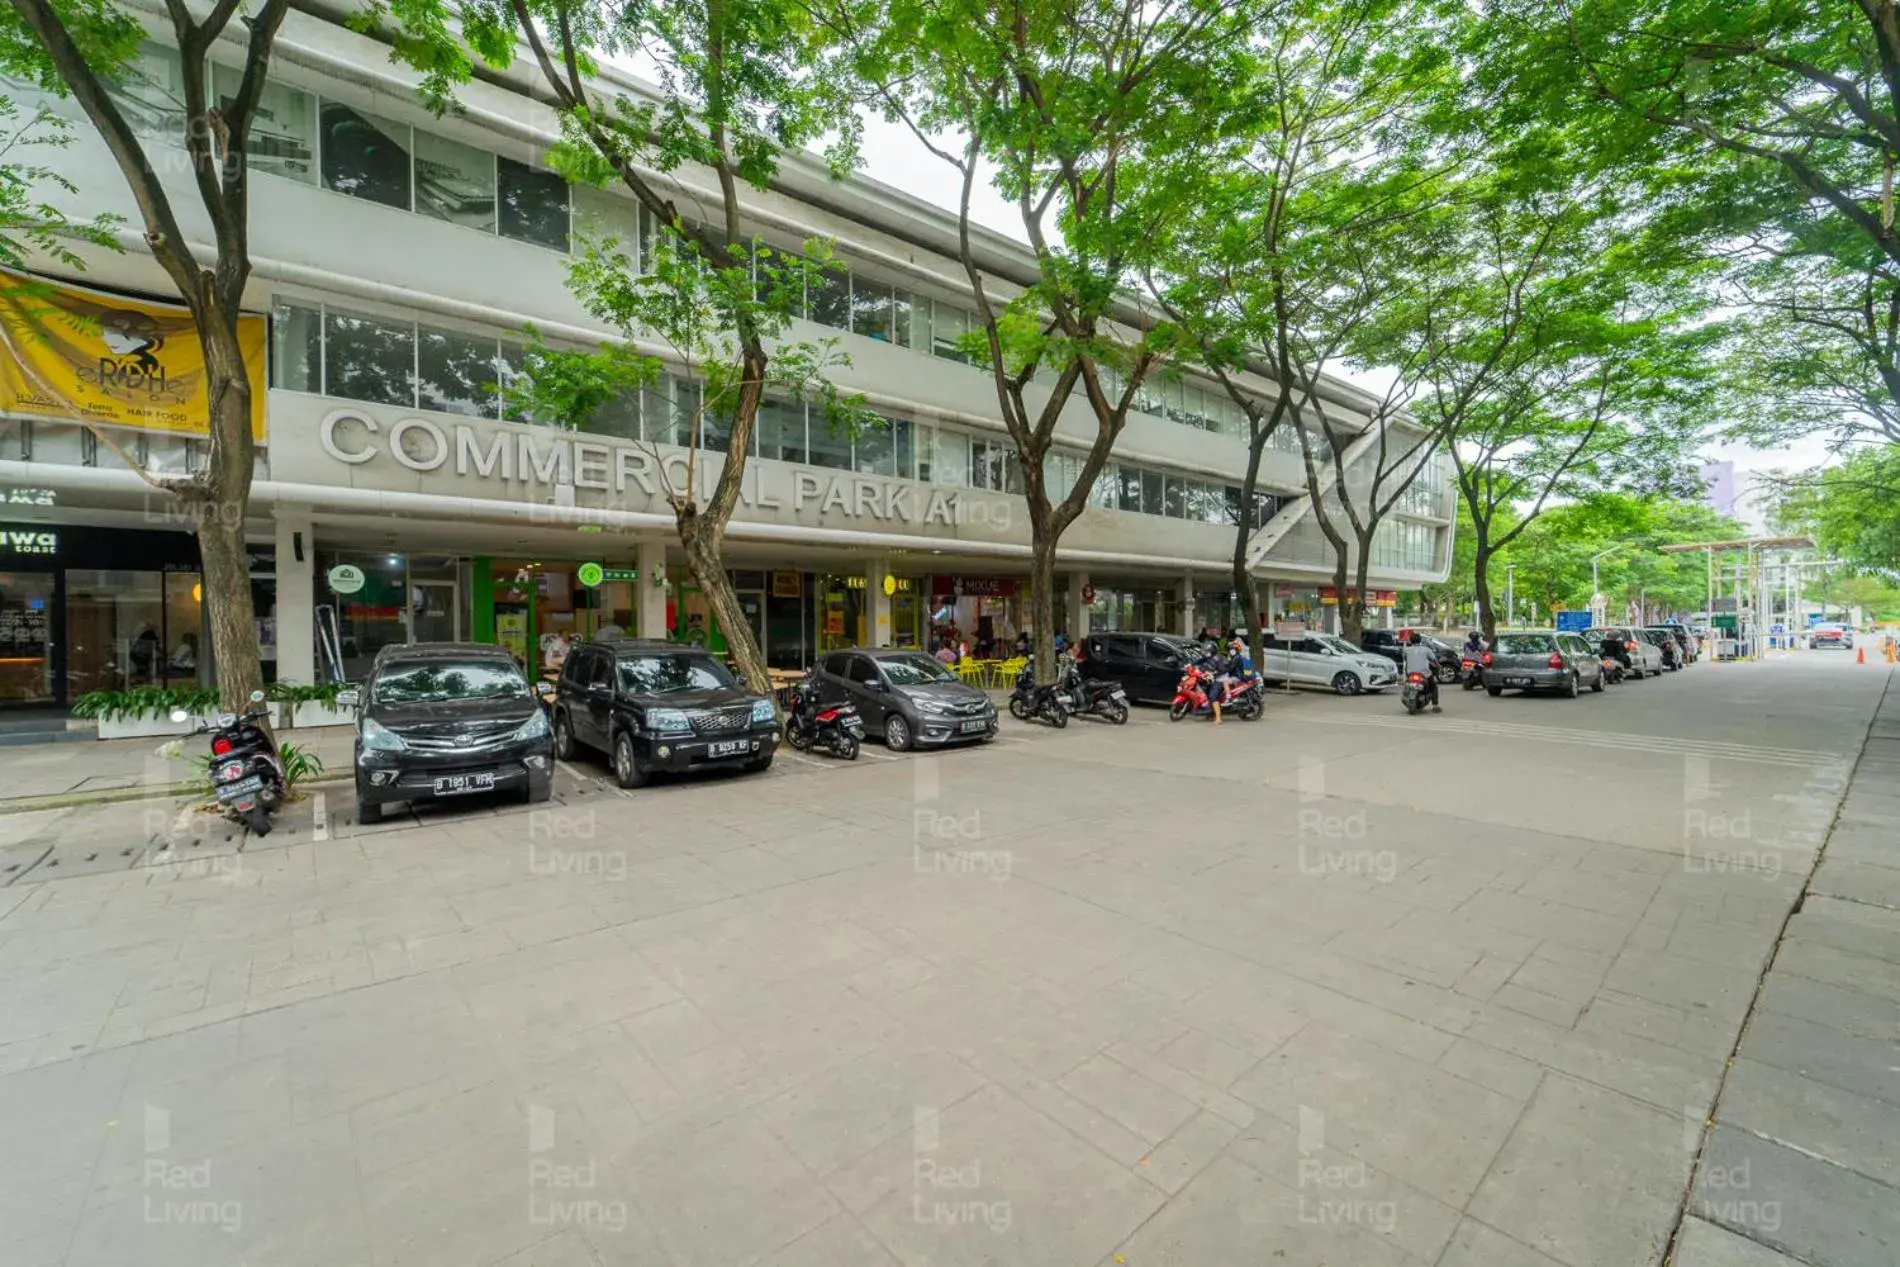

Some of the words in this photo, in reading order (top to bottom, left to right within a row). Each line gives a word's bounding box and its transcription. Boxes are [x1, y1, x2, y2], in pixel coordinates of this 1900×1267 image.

[320, 408, 780, 510] COMMERCIL
[794, 469, 909, 522] PARK
[922, 490, 962, 527] A1
[15, 545, 56, 554] toast
[966, 579, 1000, 593] MIXUE
